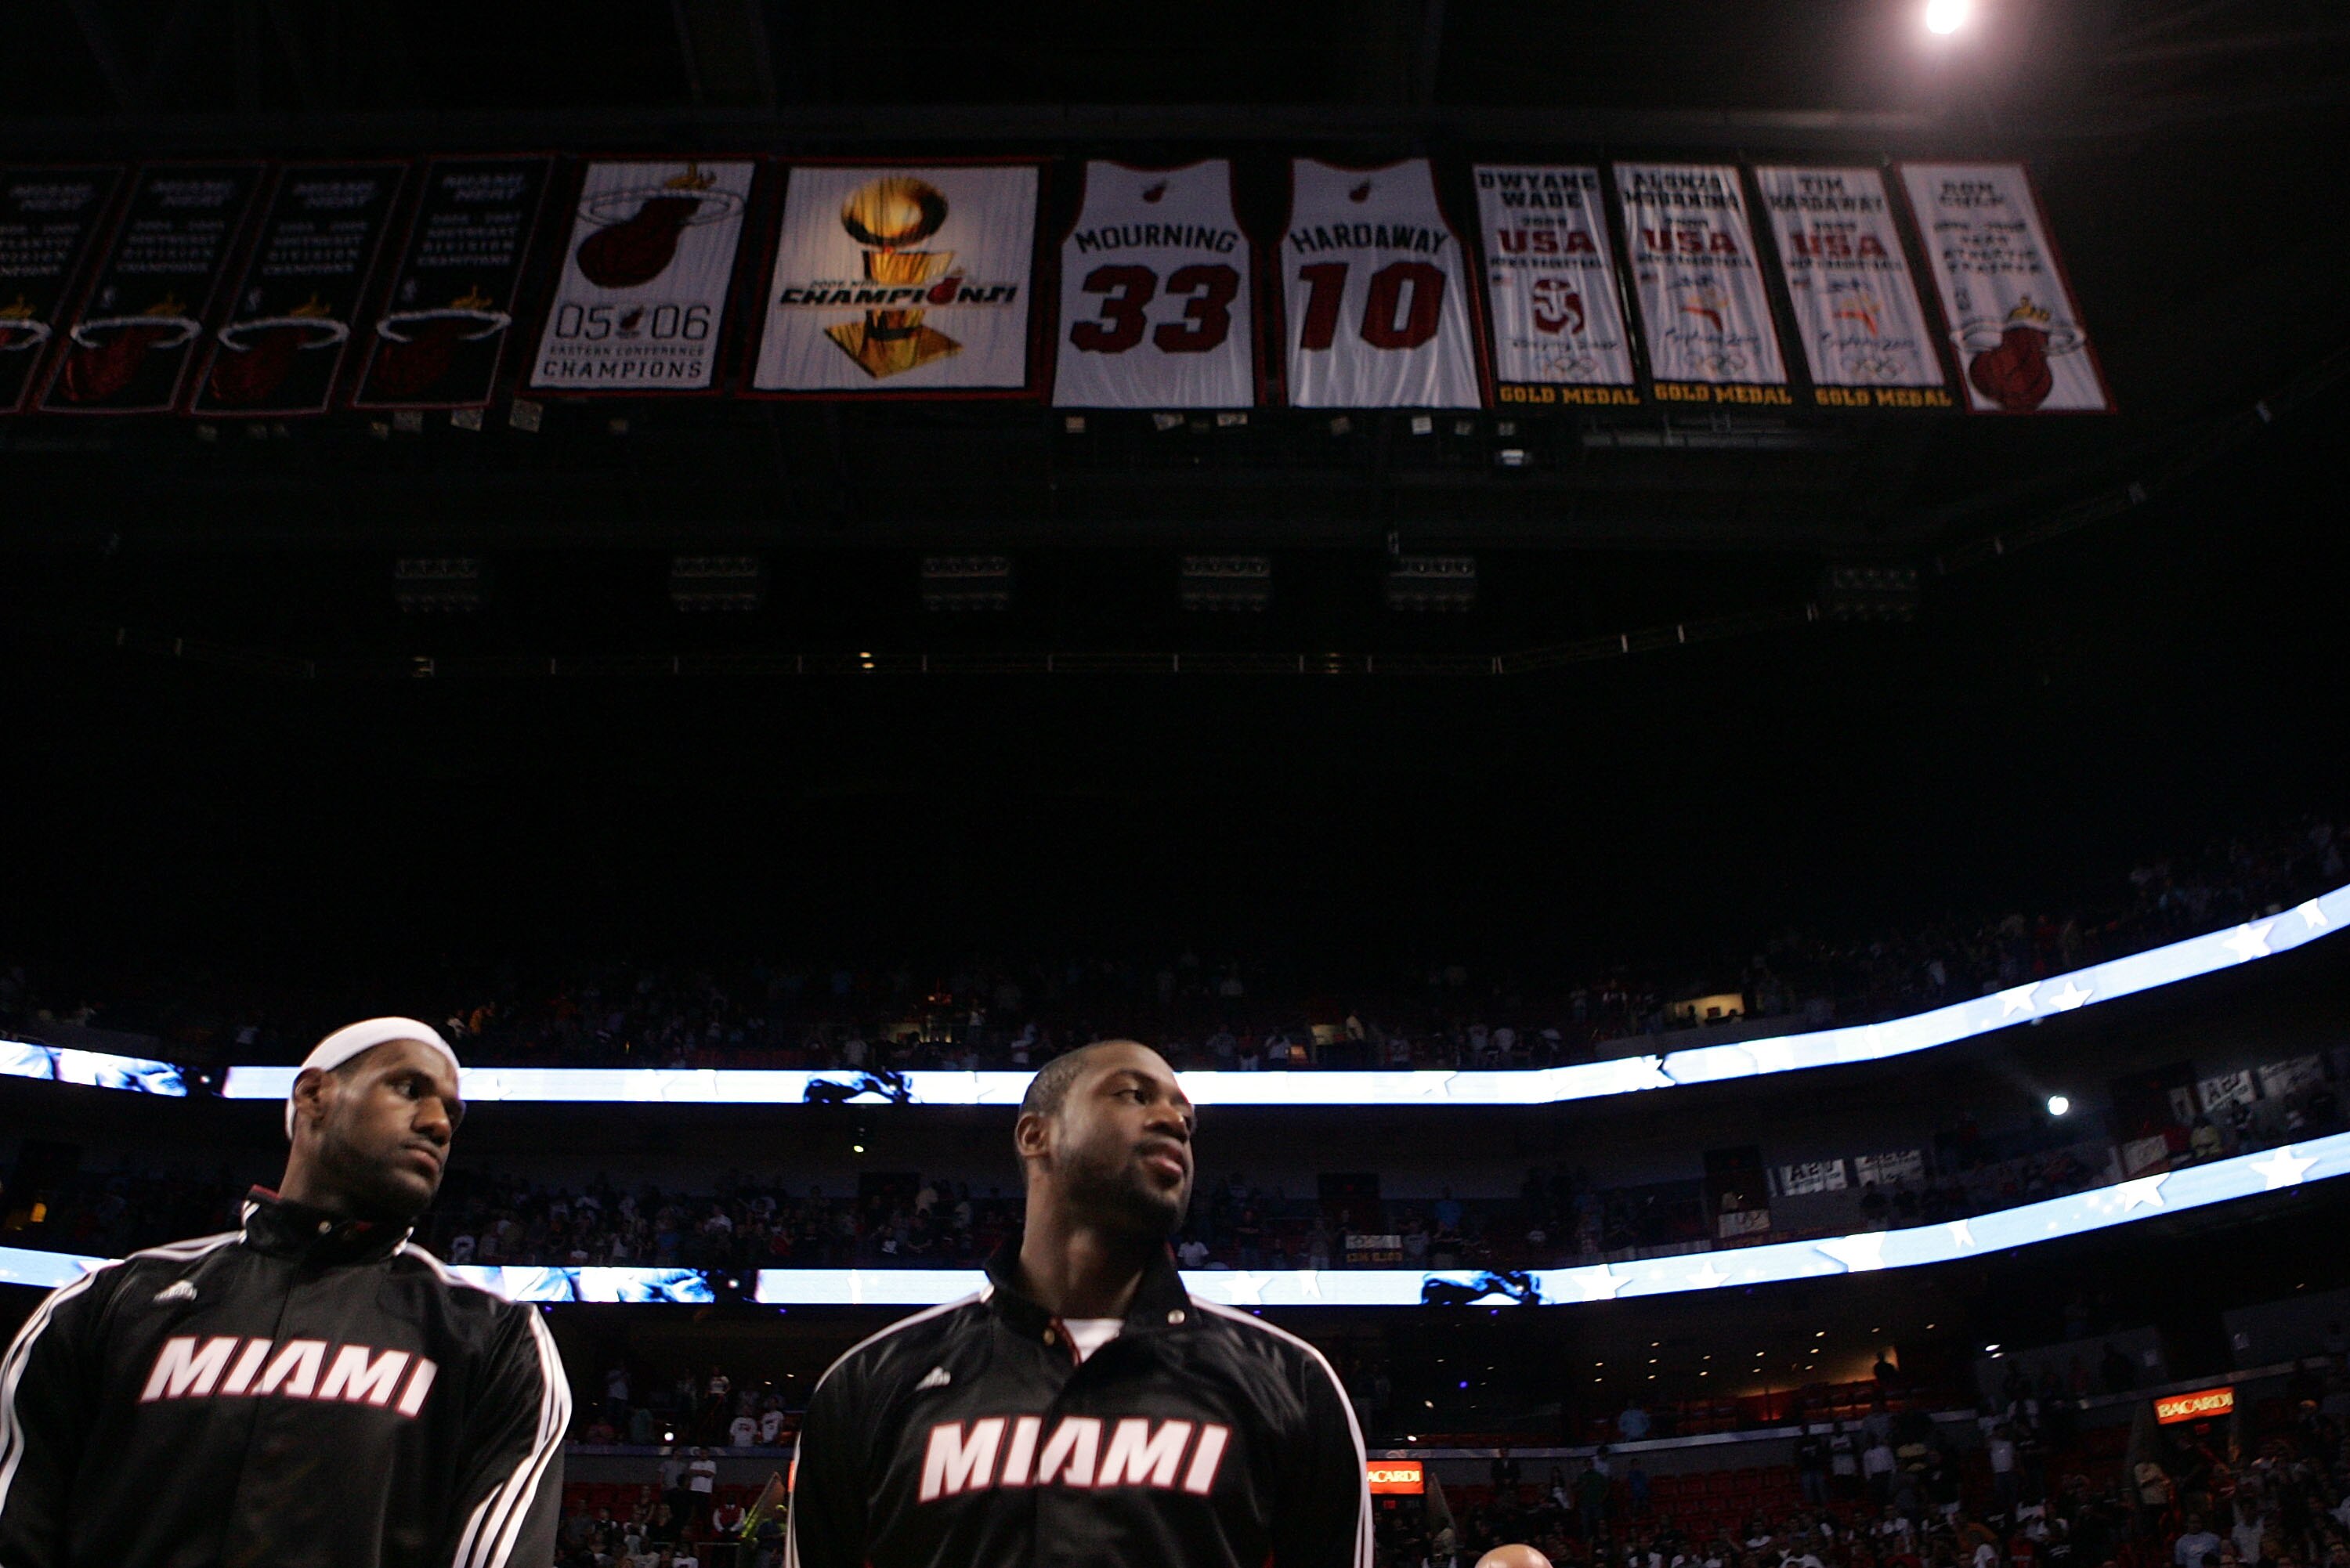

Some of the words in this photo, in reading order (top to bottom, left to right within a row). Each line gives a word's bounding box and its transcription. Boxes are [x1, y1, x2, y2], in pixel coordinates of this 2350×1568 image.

[1479, 174, 1597, 189] DWYANE
[1799, 176, 1842, 192] TIM
[1502, 192, 1582, 208] WADE
[1076, 224, 1238, 253] MOURNING
[1289, 223, 1449, 254] HARDAWAY
[1499, 230, 1596, 253] USA
[1643, 229, 1737, 253] USA
[1791, 233, 1888, 257] USA
[1070, 264, 1239, 352] 33
[1299, 262, 1445, 350] 10
[556, 303, 614, 340] 05
[652, 305, 710, 340] 06
[544, 360, 702, 378] CHAMPIONS
[1499, 385, 1556, 404] GOLD
[1562, 386, 1643, 406] MEDAL
[1654, 382, 1710, 401] GOLD
[1713, 385, 1793, 405] MEDAL
[1814, 387, 1871, 406] GOLD
[1875, 388, 1954, 407] MEDAL
[136, 1335, 439, 1421] MIAMI
[2157, 1392, 2235, 1418] BACARDI
[916, 1414, 1233, 1505] MIAMI
